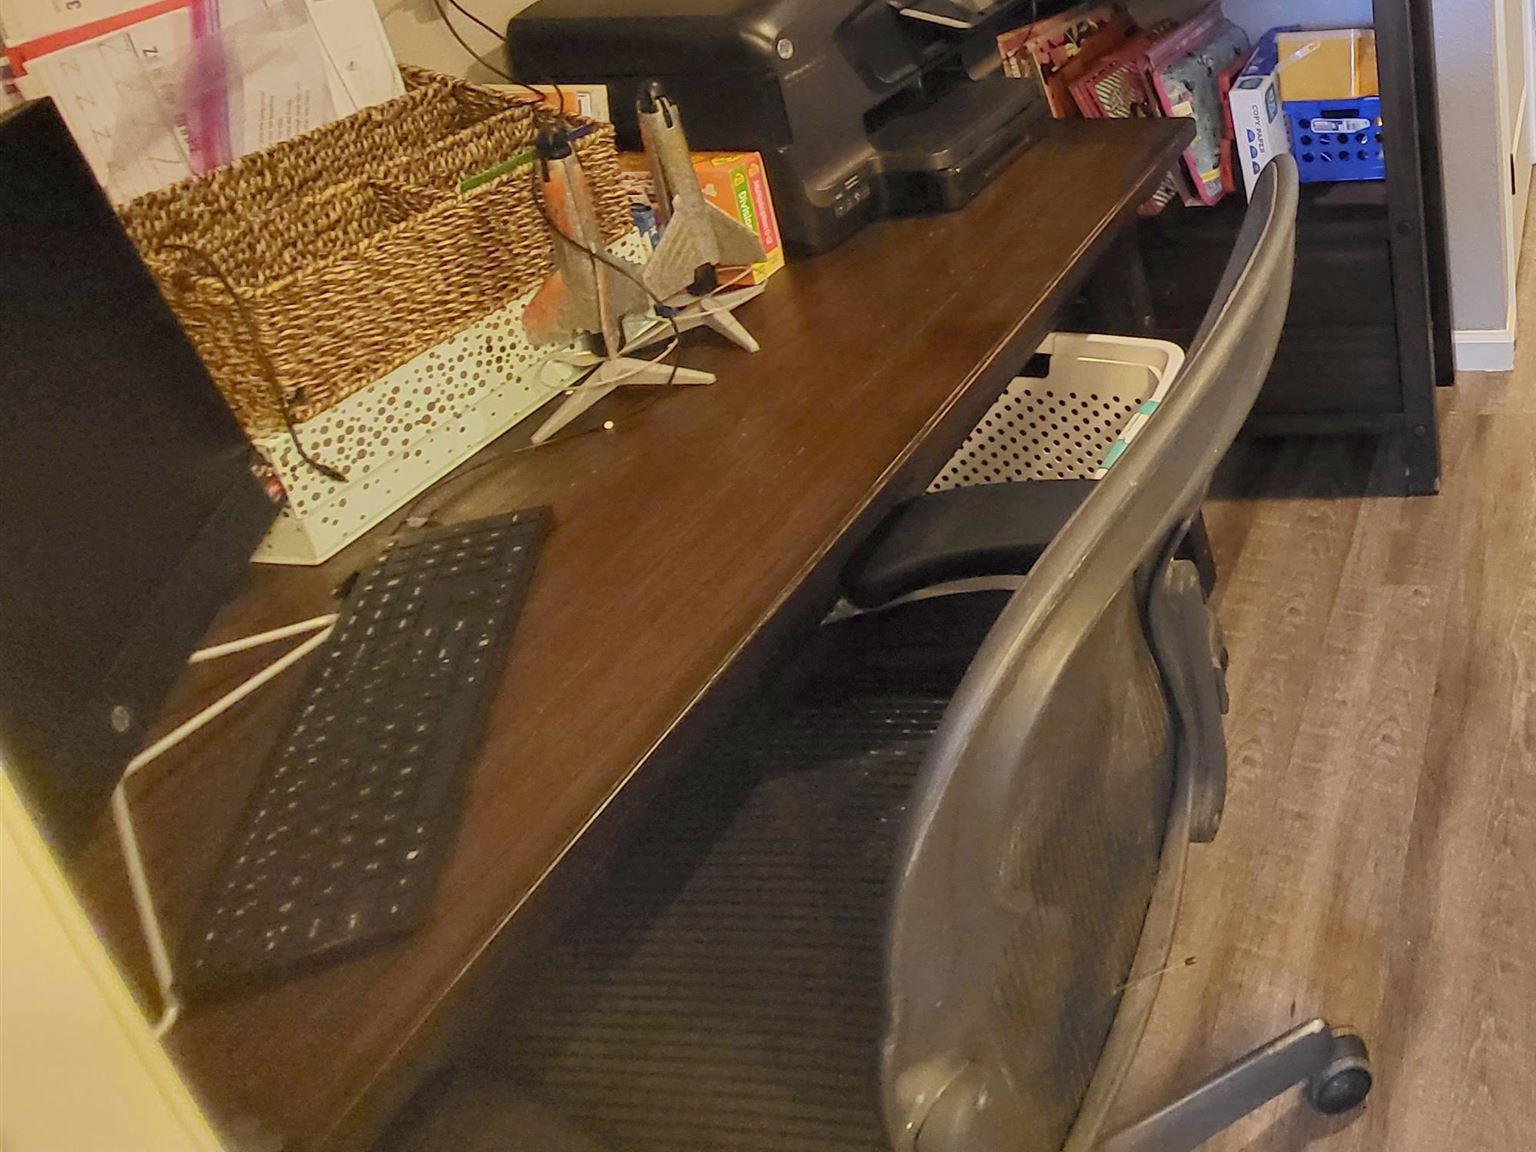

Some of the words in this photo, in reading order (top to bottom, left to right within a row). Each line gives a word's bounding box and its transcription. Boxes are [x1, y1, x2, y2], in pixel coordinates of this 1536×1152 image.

[65, 0, 83, 10] 3
[1251, 104, 1262, 126] COPY
[1256, 127, 1266, 154] PAPER
